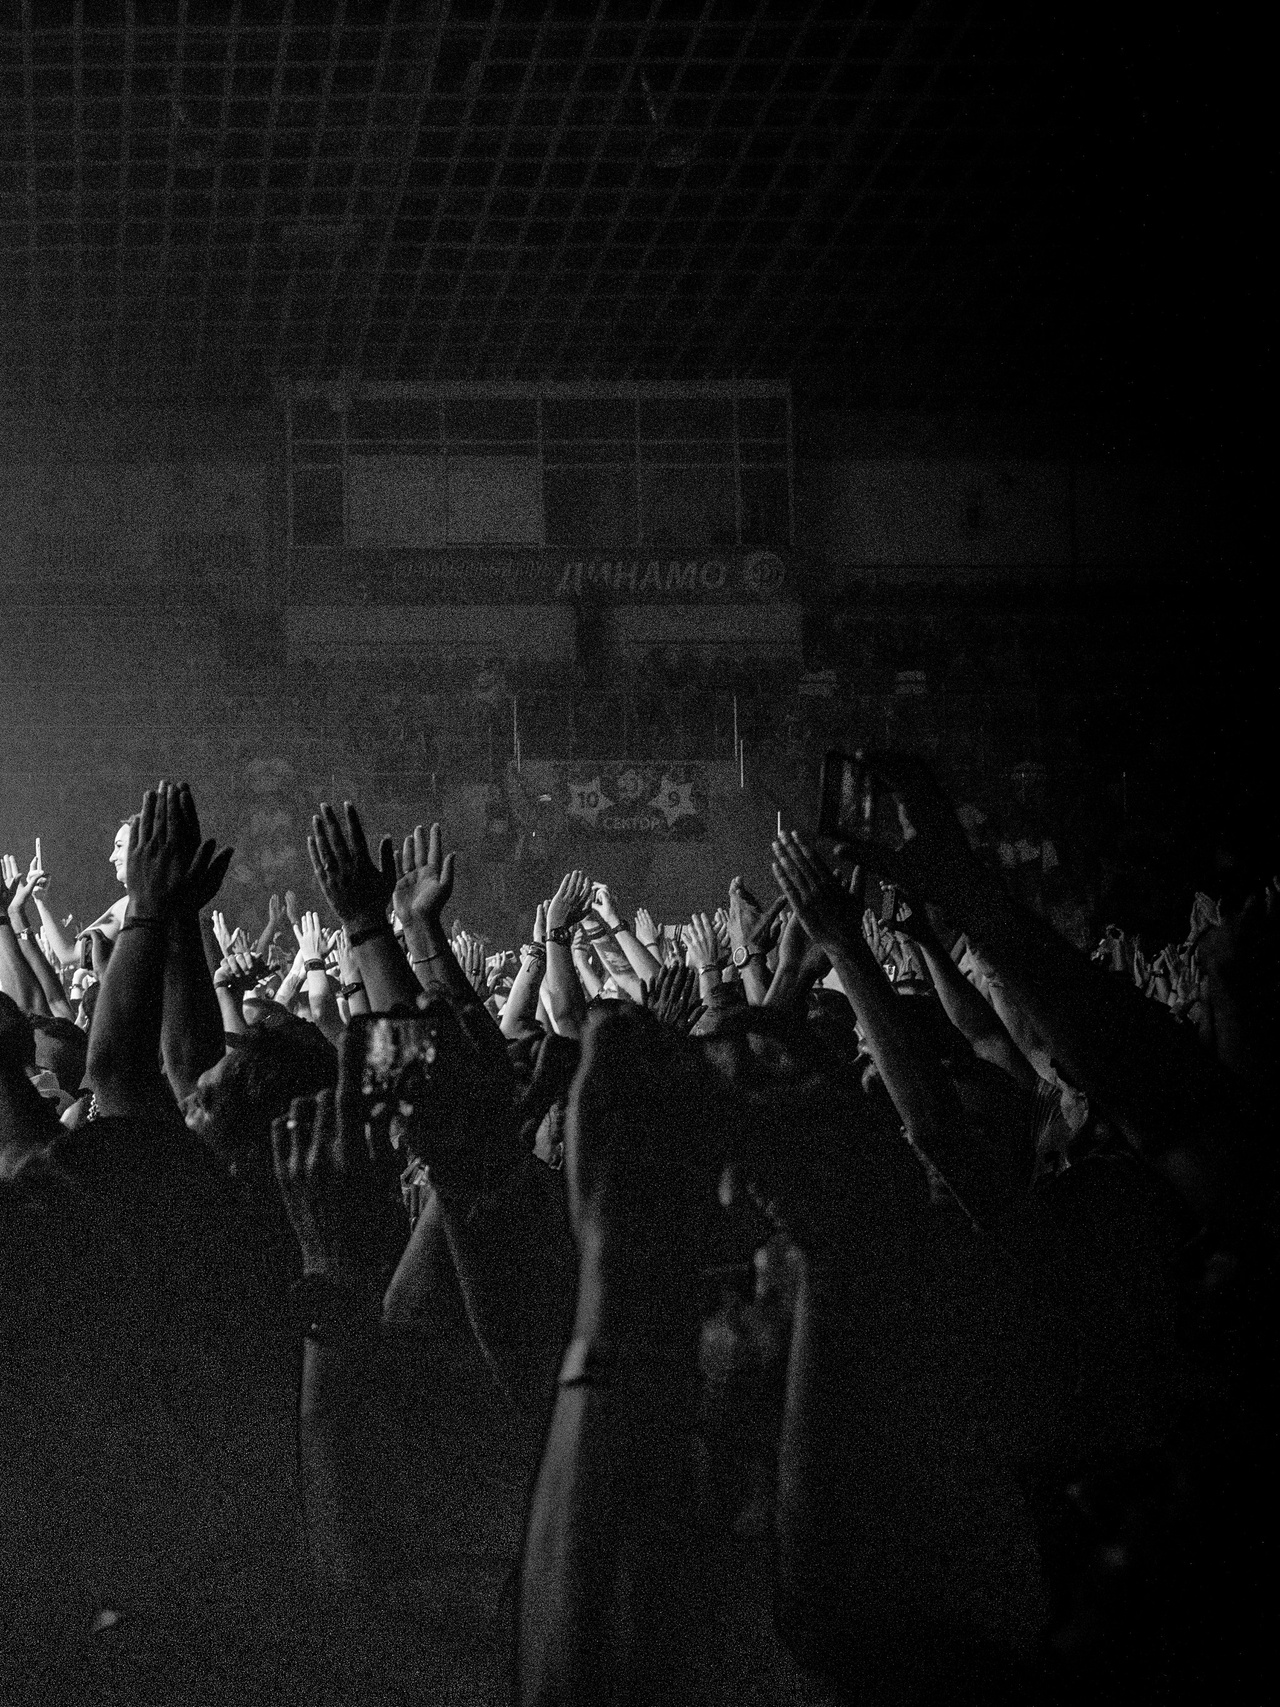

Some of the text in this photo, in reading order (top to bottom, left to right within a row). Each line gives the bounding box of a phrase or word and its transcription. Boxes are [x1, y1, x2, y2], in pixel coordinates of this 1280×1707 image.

[577, 791, 599, 808] 10
[668, 791, 681, 808] 9
[602, 816, 661, 830] СЕКТОР
